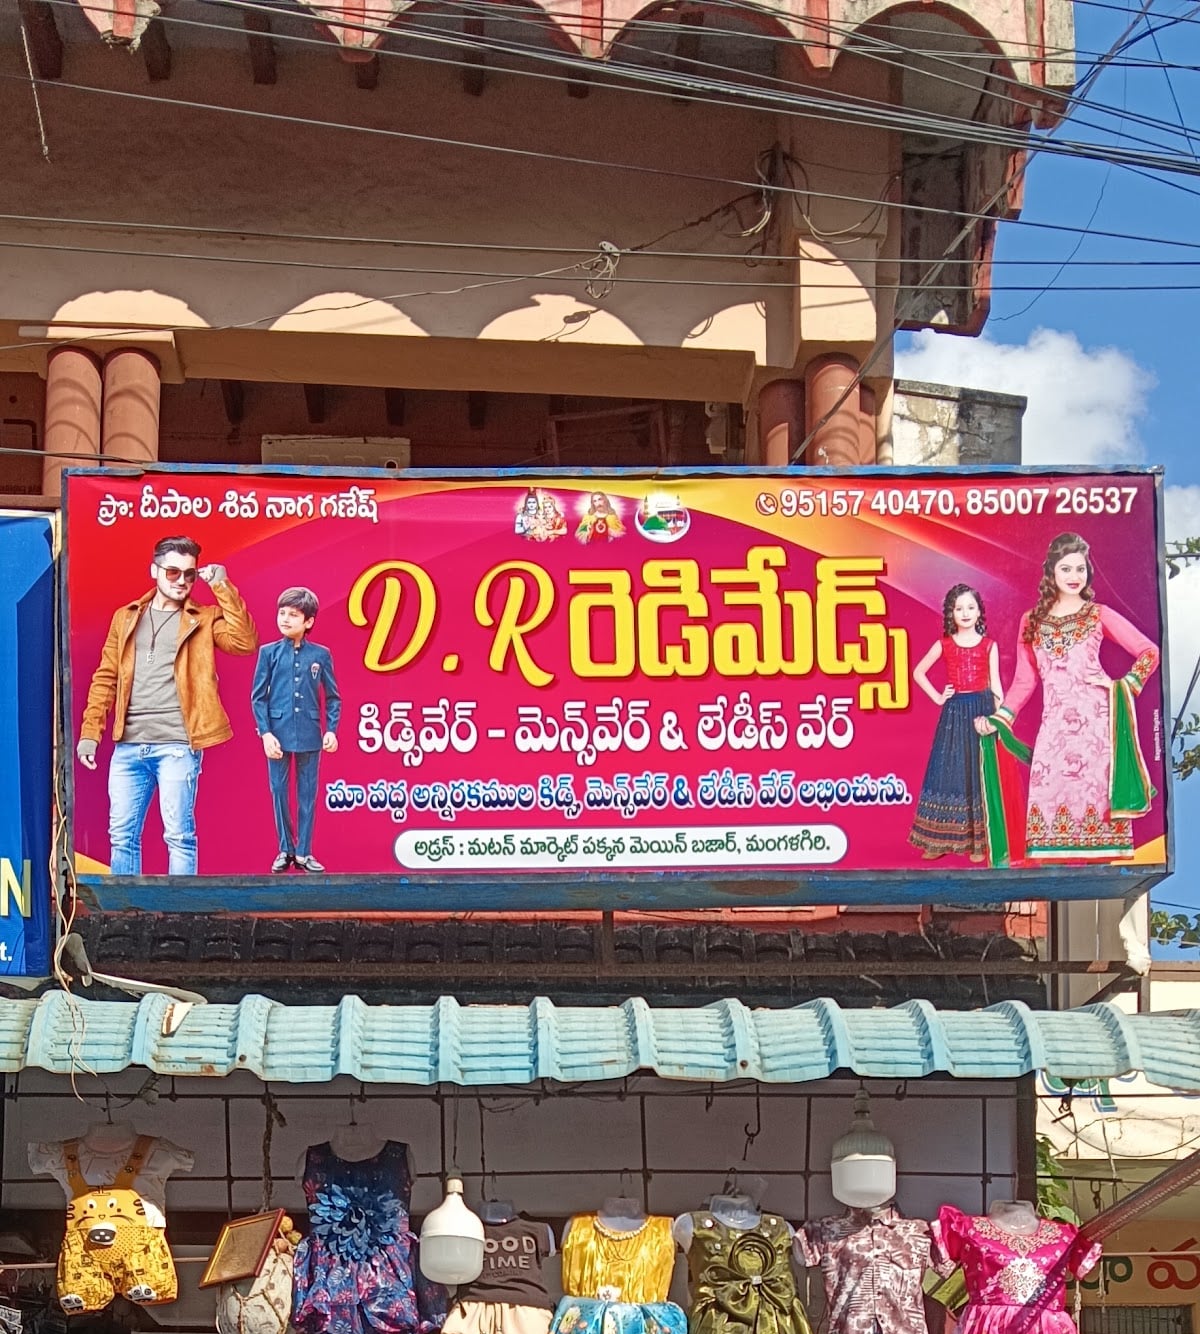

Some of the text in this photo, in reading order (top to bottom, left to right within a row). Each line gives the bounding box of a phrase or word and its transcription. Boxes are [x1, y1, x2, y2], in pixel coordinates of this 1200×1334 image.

[140, 486, 212, 519] దీపాల
[218, 490, 259, 519] శివ
[266, 494, 314, 519] నాగ
[319, 486, 380, 525] గణేష్
[780, 486, 1139, 518] 95157 40470, 85007 26537
[567, 545, 912, 713] రెడిమేడ్స్
[659, 710, 689, 752] &
[697, 691, 789, 752] లేడీస్
[796, 694, 855, 749] వేర్
[326, 780, 366, 811] మా
[369, 779, 408, 822] వద్ద
[673, 775, 694, 808] &
[698, 767, 754, 808] లేడీస్
[757, 769, 796, 807] వేర్
[413, 835, 456, 863] అడ్రస్
[467, 834, 517, 857] మటన్
[519, 834, 580, 863] మార్కెట్
[582, 837, 626, 862] పక్కన
[629, 832, 689, 855] మెయిన్
[484, 1236, 537, 1254] OOD
[484, 1255, 531, 1270] IME
